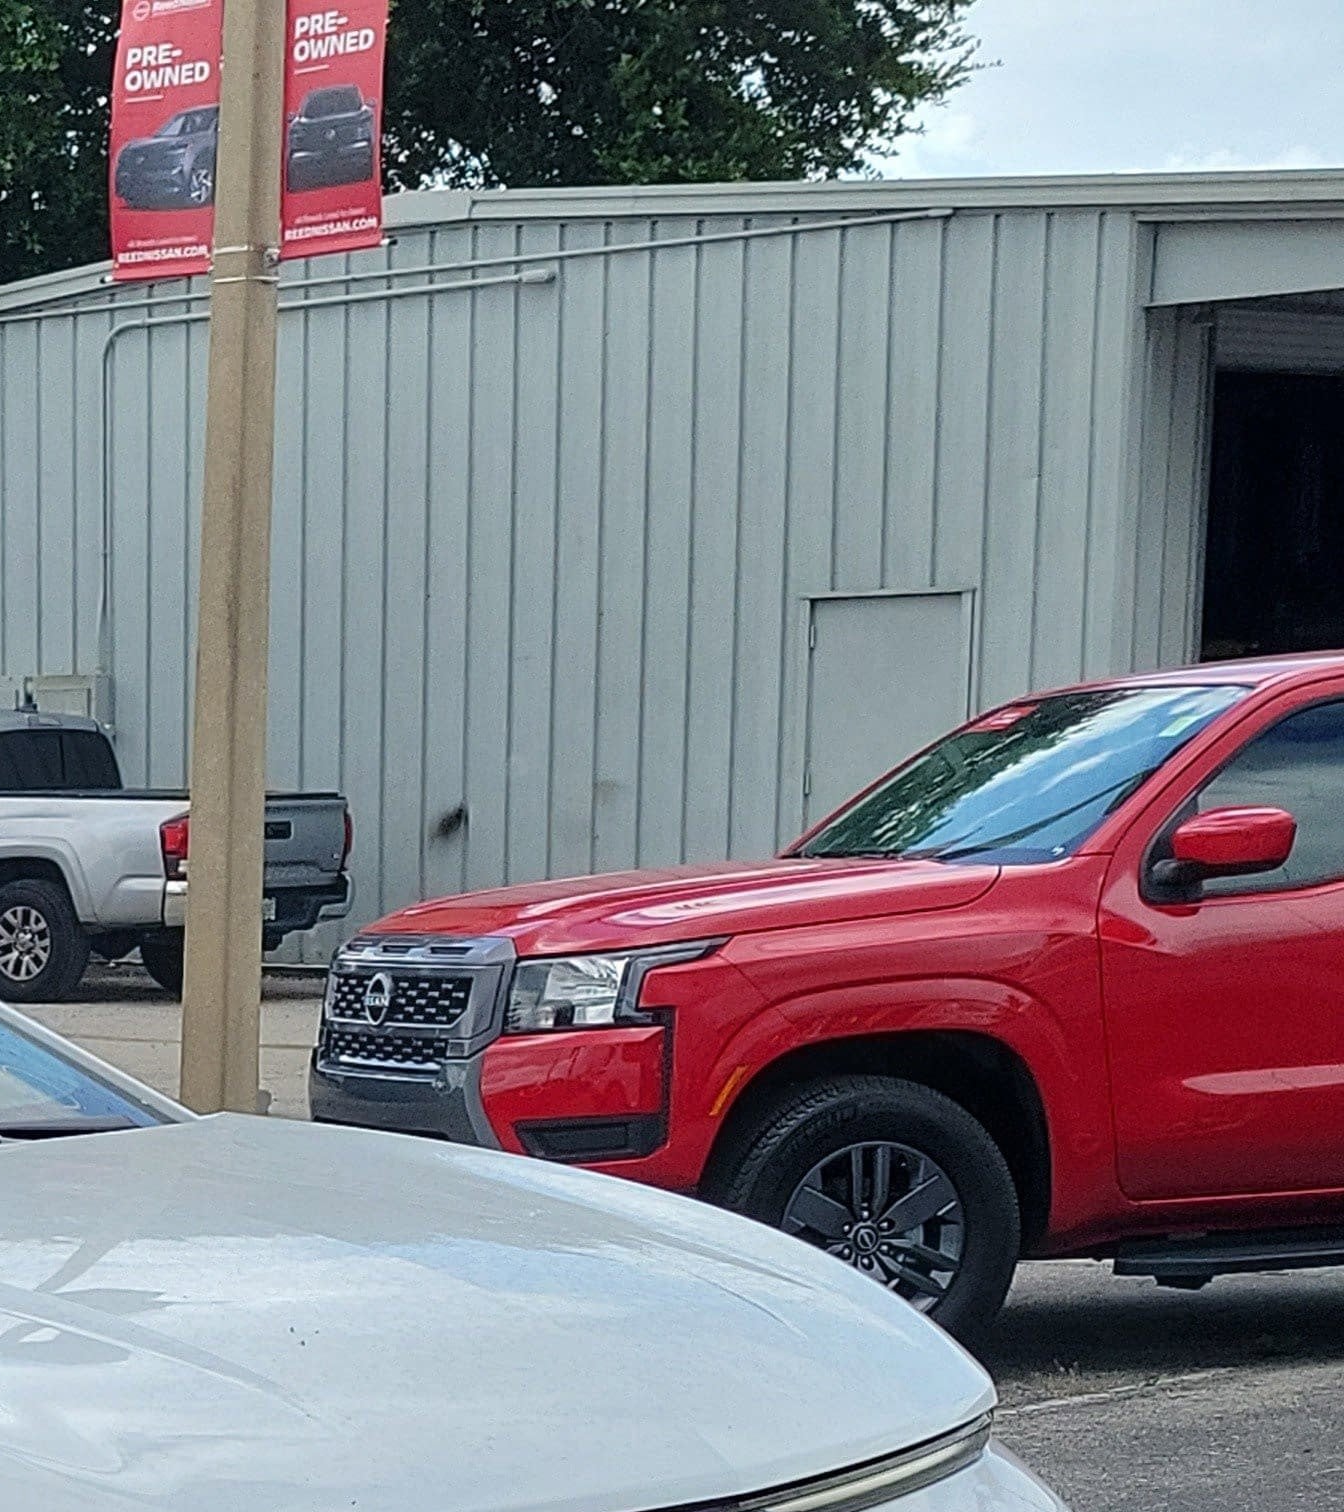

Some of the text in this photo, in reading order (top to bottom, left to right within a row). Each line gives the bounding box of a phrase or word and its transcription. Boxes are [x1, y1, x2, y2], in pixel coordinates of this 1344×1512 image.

[294, 10, 348, 40] PRE-
[126, 43, 183, 70] PRE-
[293, 28, 375, 63] OWNED
[124, 61, 210, 92] OWNED
